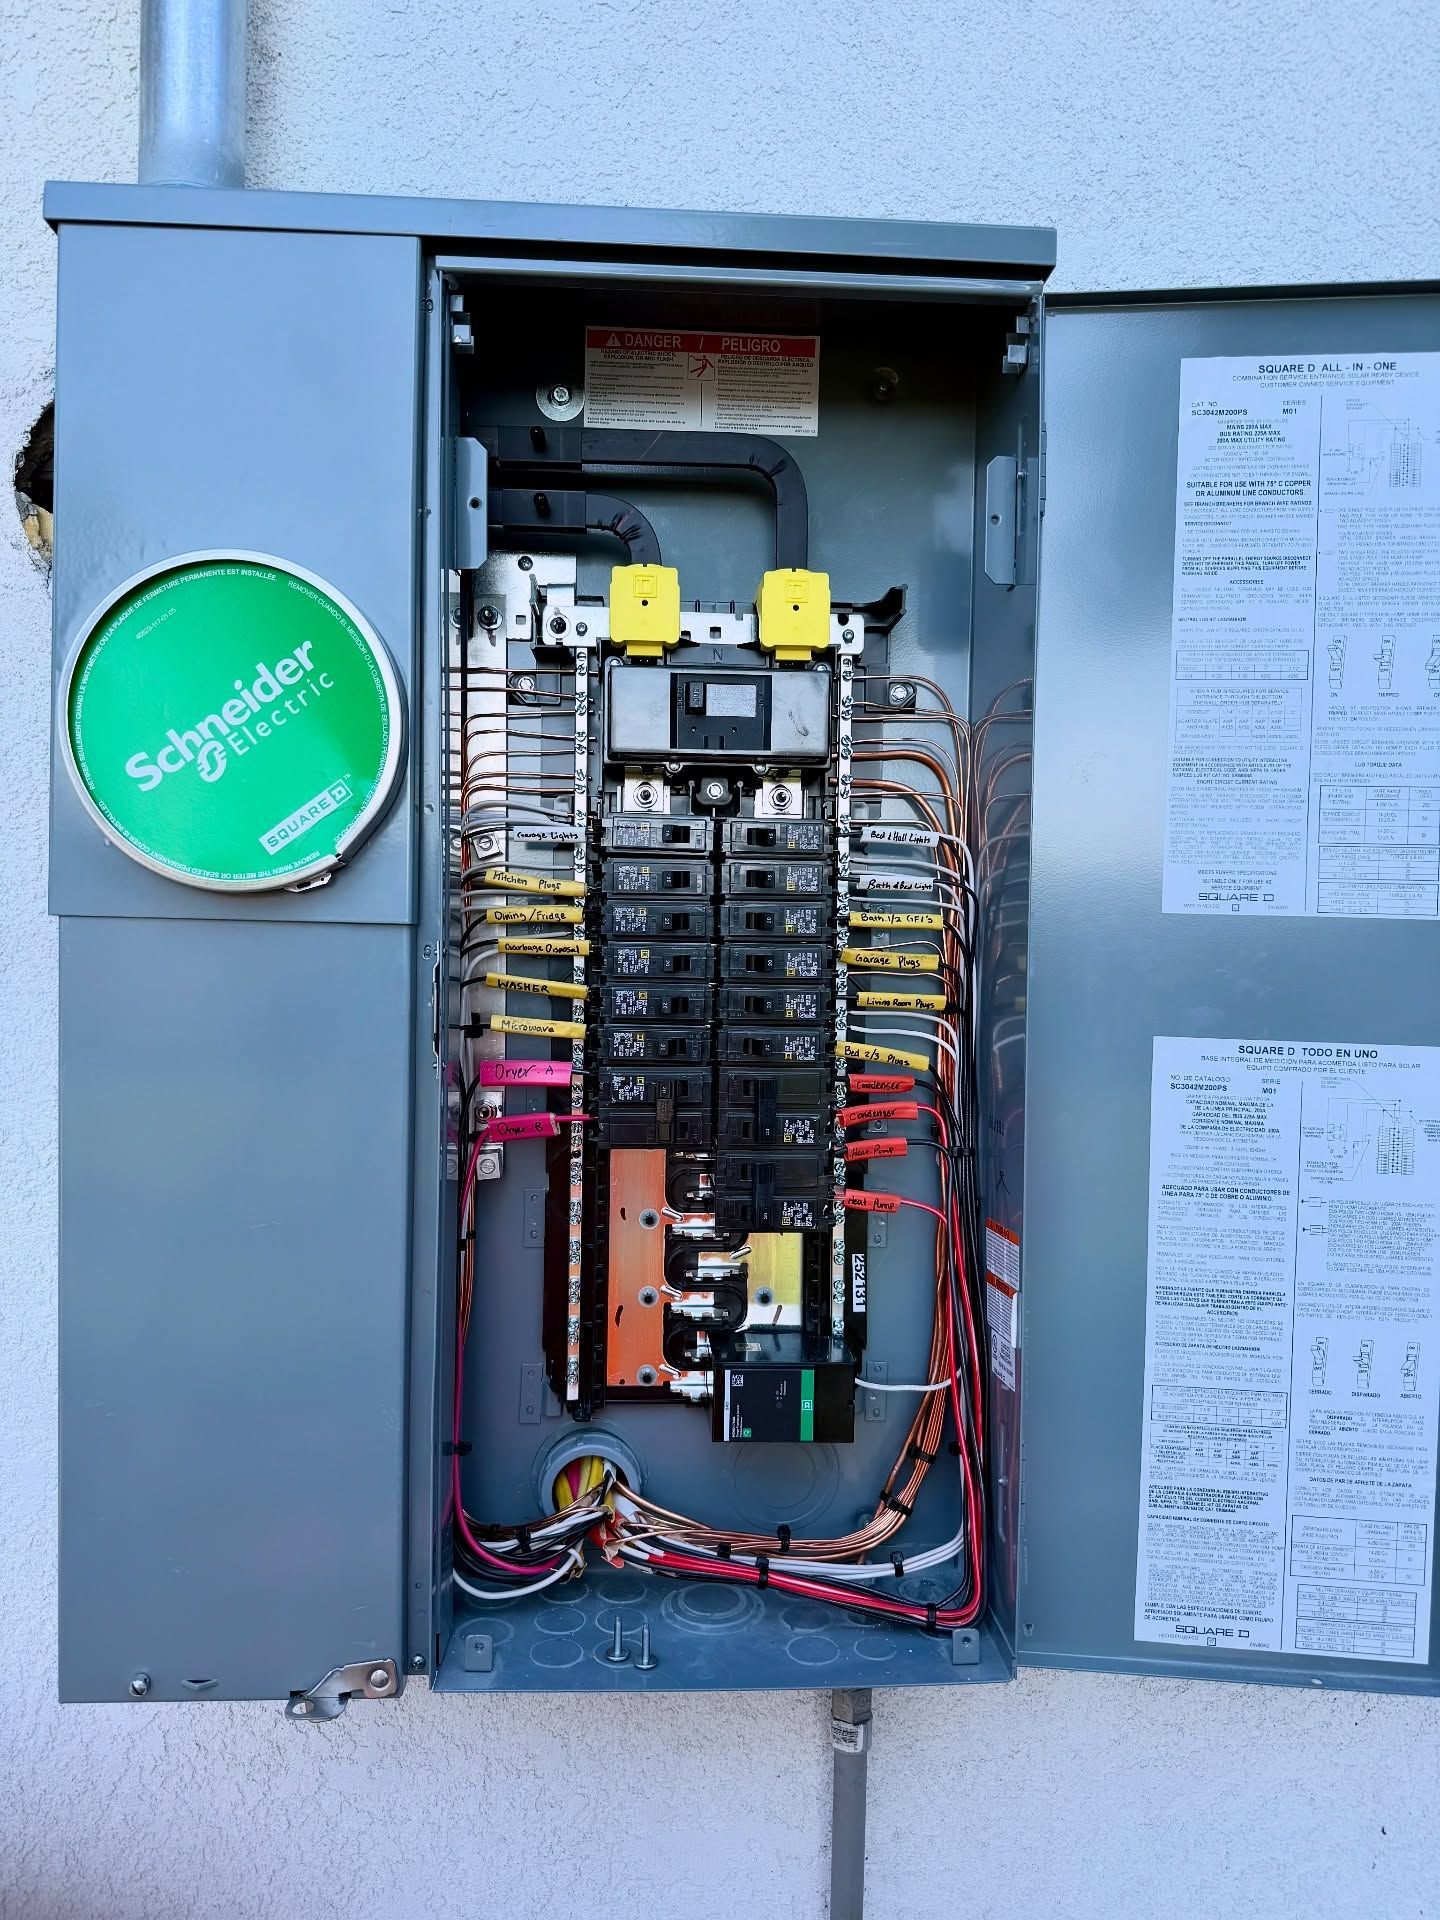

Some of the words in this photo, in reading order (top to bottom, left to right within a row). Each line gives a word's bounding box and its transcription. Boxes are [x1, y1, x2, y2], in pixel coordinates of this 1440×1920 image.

[625, 333, 682, 349] DANGER
[722, 337, 780, 353] PELIGRO
[1258, 364, 1305, 374] SQUARE
[1308, 363, 1316, 373] D
[1321, 363, 1342, 372] ALL
[1352, 362, 1363, 371] IN
[1373, 361, 1397, 371] ONE
[180, 568, 227, 584] PERMANENTE
[226, 568, 240, 576] EST
[142, 579, 181, 603] FERMETURE
[133, 599, 145, 609] DE
[112, 606, 135, 631] PLAQUE
[287, 580, 319, 601] REMOVER
[318, 598, 342, 620] CUANDO
[340, 619, 348, 628] EL
[346, 626, 368, 655] MEDIDOR
[366, 661, 375, 671] LA
[99, 635, 109, 646] OU
[713, 647, 723, 661] N
[75, 694, 84, 720] QUAND
[124, 640, 313, 792] Schneider
[228, 671, 335, 757] Electric
[75, 721, 86, 762] SEULEMENT
[267, 797, 332, 848] SQUARE
[122, 830, 131, 839] IS
[517, 831, 548, 841] Garage
[550, 831, 579, 841] Lights
[870, 830, 886, 840] Bed
[893, 831, 908, 842] Hall
[908, 833, 931, 845] Lights
[128, 834, 151, 853] COVER
[150, 849, 191, 872] PERMANENT
[293, 850, 321, 868] REMOVE
[191, 867, 221, 879] SEALED
[257, 869, 273, 878] THE
[272, 862, 294, 875] WHEN
[220, 872, 232, 880] OR
[232, 872, 257, 880] METER
[538, 878, 562, 891] Plugs
[867, 878, 891, 890] Bath
[1198, 892, 1259, 902] SQUARE
[1263, 893, 1275, 902] D
[494, 911, 527, 922] Dining
[860, 912, 884, 922] Bath
[887, 913, 902, 924] 1/2
[504, 942, 544, 953] Garbage
[545, 942, 580, 954] Disposal
[855, 953, 891, 965] Garage
[898, 955, 921, 968] Plugs
[497, 978, 550, 994] WASHER
[866, 996, 891, 1007] Living
[893, 998, 913, 1007] Room
[915, 999, 935, 1009] Plugs
[501, 1020, 555, 1033] Microwave
[844, 1045, 860, 1058] Bed
[864, 1049, 880, 1060] 2/3
[887, 1053, 911, 1066] Plugs
[1238, 1045, 1284, 1055] SQUARE
[1287, 1047, 1296, 1056] D
[1302, 1047, 1333, 1057] TODO
[1336, 1049, 1351, 1058] EN
[1354, 1049, 1378, 1059] UNO
[544, 1066, 554, 1075] A
[856, 1079, 904, 1090] Condenser
[1170, 1083, 1228, 1092] SC3042M200PS
[850, 1107, 897, 1120] Condenser
[851, 1145, 869, 1158] Heat
[872, 1145, 895, 1157] Pump
[848, 1194, 867, 1206] Heat
[872, 1197, 895, 1209] Pump
[1175, 1625, 1234, 1637] SQUARE
[1238, 1629, 1250, 1638] D
